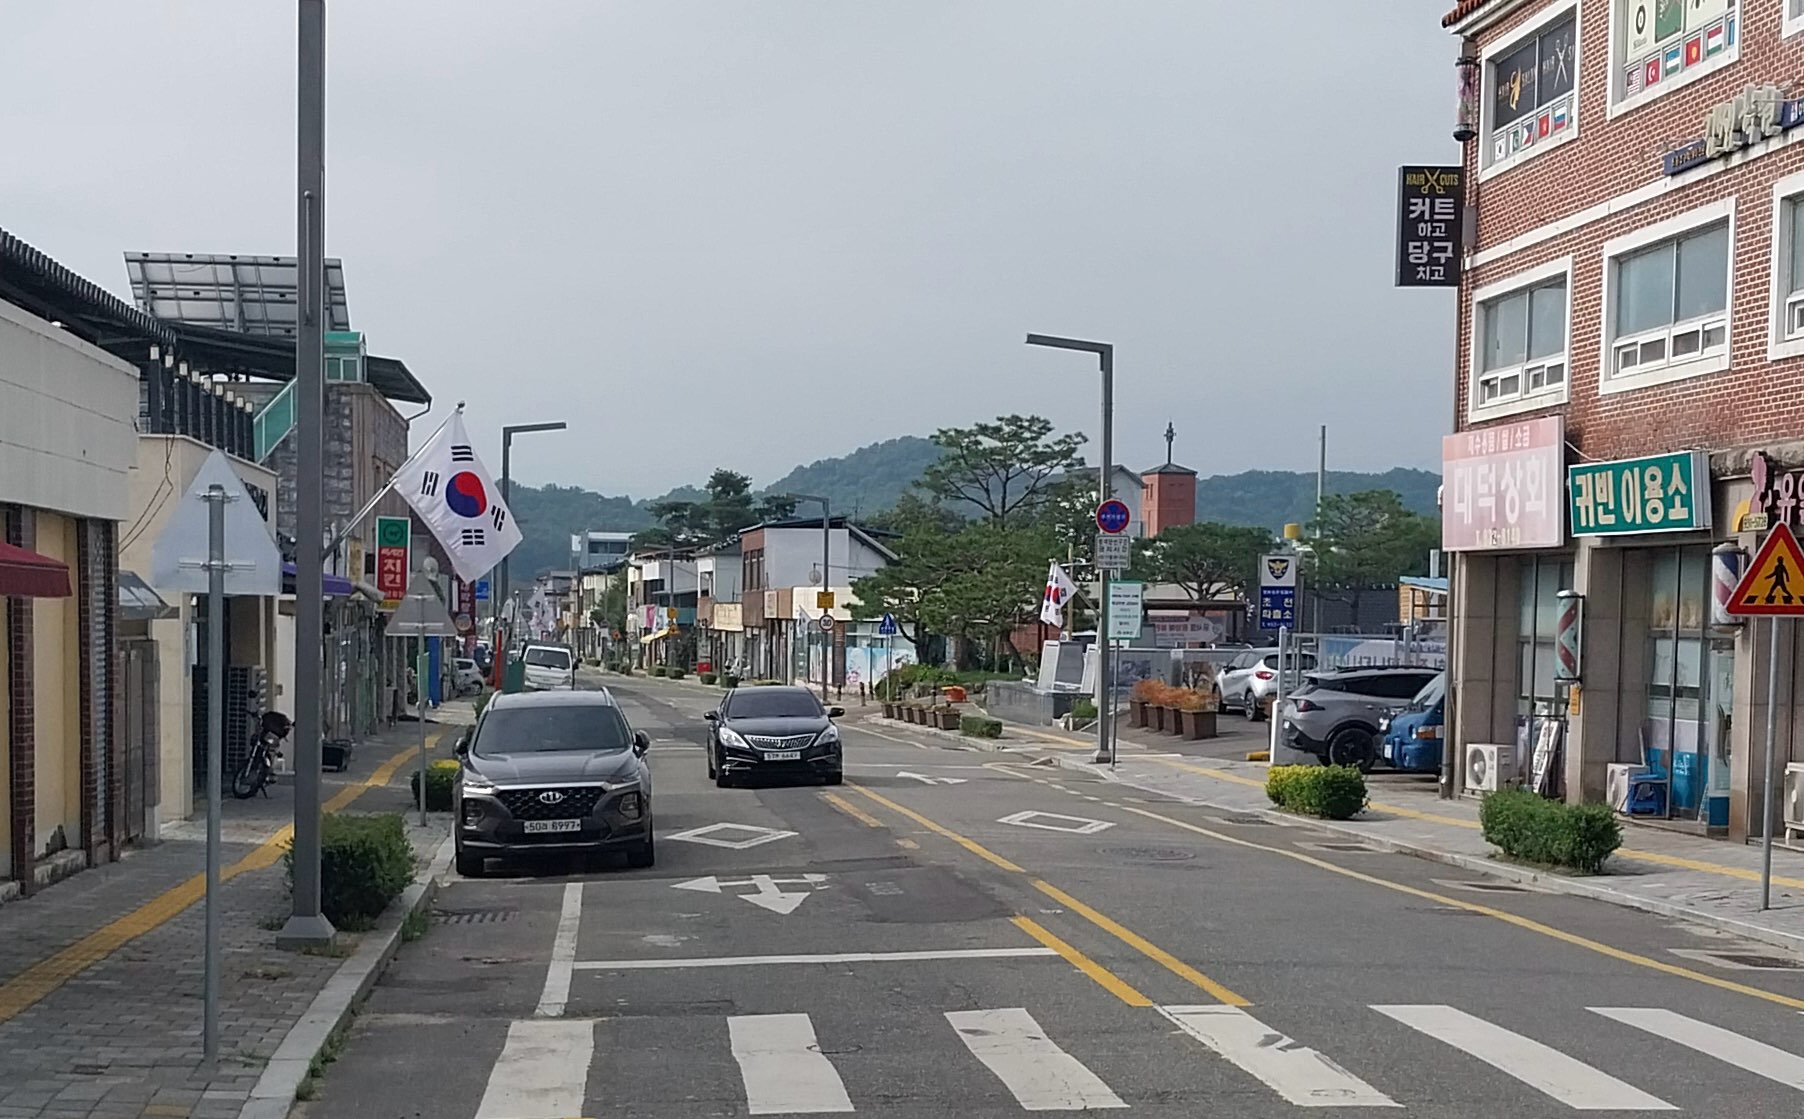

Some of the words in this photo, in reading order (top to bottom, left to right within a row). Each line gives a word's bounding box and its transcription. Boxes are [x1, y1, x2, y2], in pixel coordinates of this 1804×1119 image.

[1406, 173, 1425, 186] HAIR
[1439, 174, 1459, 186] CUTS
[1408, 197, 1455, 220] 커트
[1417, 222, 1446, 237] 하고
[1408, 241, 1454, 264] 당구
[1416, 266, 1445, 280] 치고
[1454, 455, 1547, 525] 대덕상회
[1575, 470, 1616, 528] 귀빈
[1621, 462, 1689, 524] 이용소
[1262, 609, 1293, 619] 파출소
